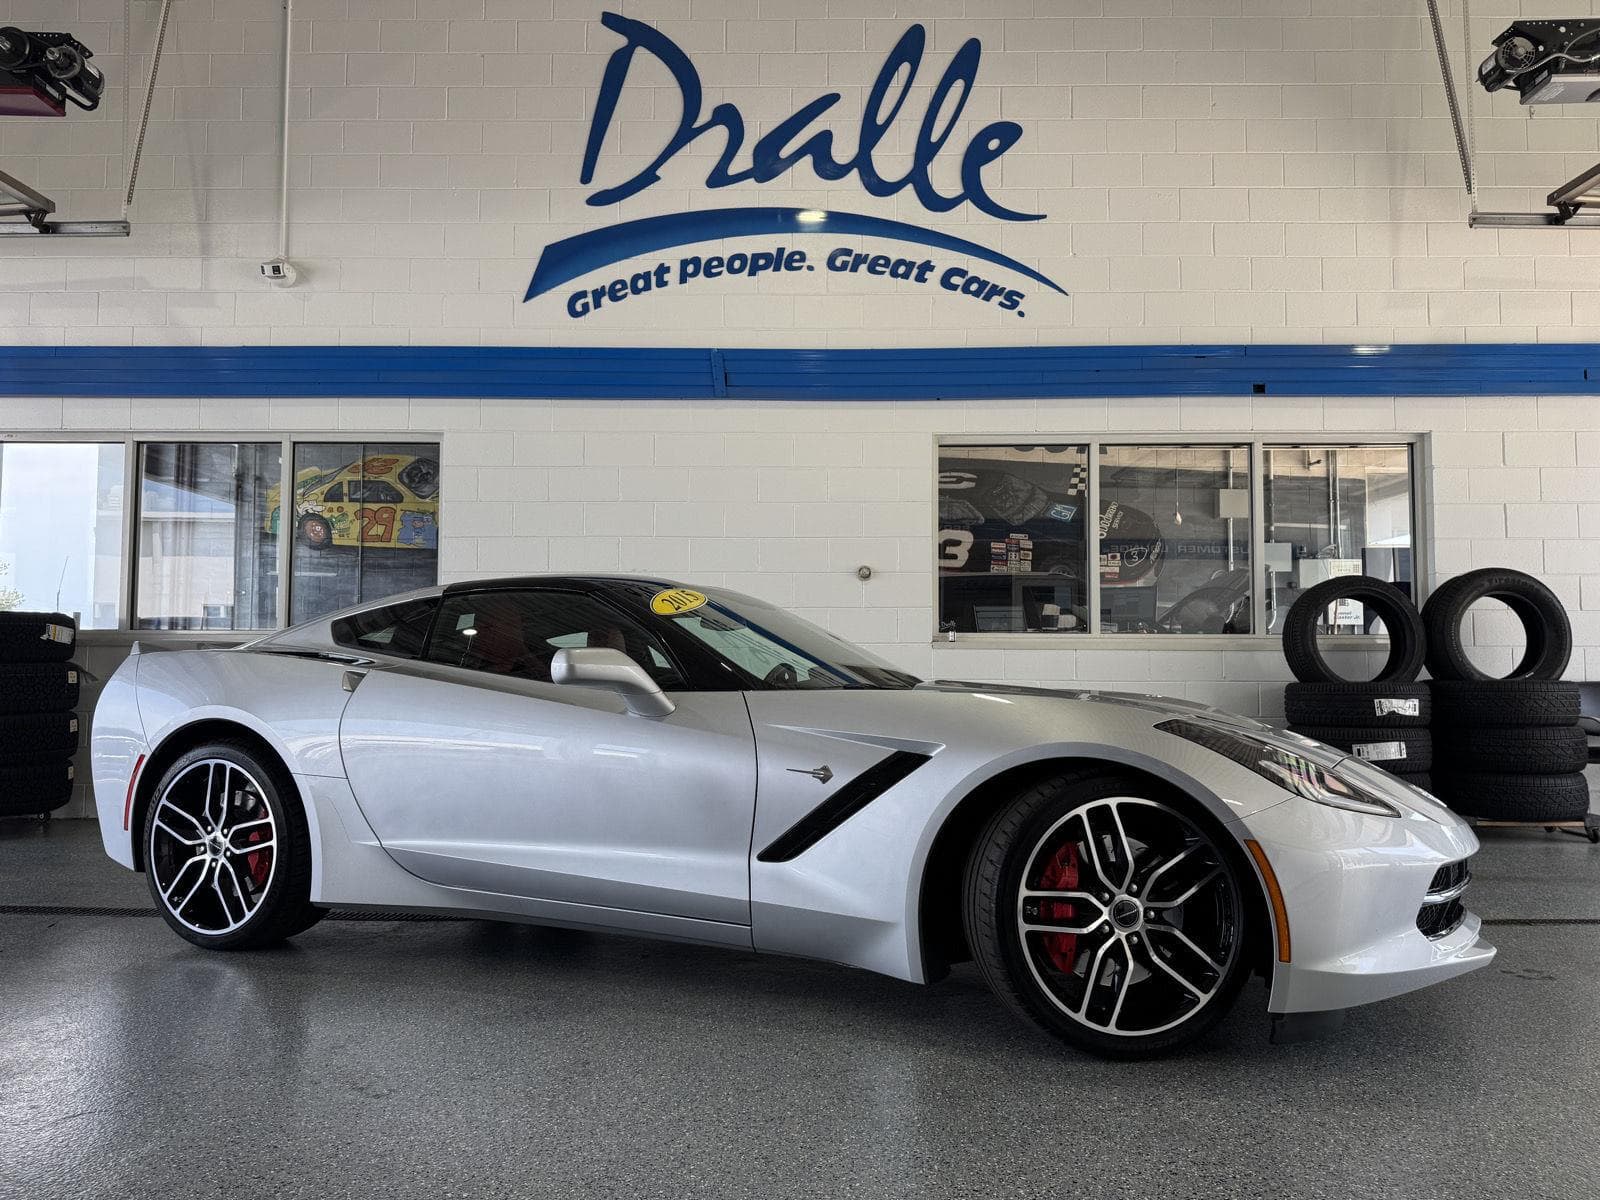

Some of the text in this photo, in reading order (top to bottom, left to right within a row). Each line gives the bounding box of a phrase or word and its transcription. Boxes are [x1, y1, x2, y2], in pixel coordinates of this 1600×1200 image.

[580, 11, 1047, 221] Dralle
[567, 247, 1025, 318] Great people. Great Cars.
[354, 506, 397, 542] 29
[939, 529, 974, 568] 3
[661, 590, 699, 611] 2015
